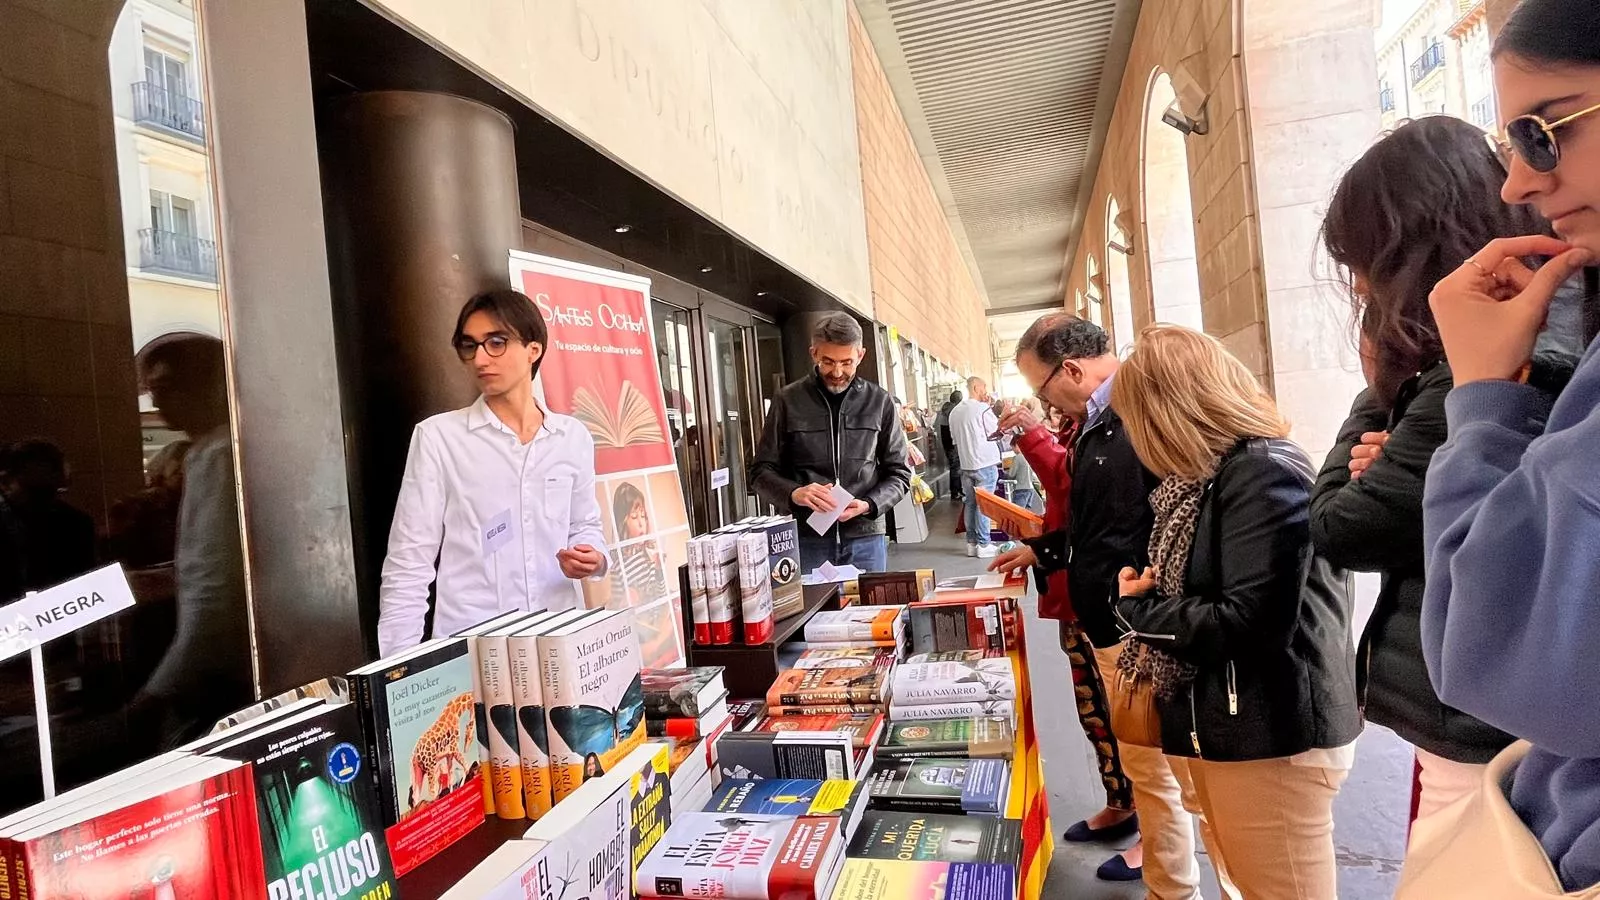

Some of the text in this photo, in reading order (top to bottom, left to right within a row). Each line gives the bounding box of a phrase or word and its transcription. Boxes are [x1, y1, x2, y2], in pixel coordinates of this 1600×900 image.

[554, 340, 564, 350] Tu
[565, 342, 592, 354] espacio
[592, 345, 601, 353] de
[602, 346, 624, 355] cultura
[770, 530, 794, 546] JAVIER
[772, 541, 794, 554] SIERRA
[36, 592, 104, 628] NEGRA
[576, 622, 632, 660] María Oruña
[484, 660, 492, 686] negro
[489, 648, 500, 698] El albatros
[518, 648, 528, 698] El albatros
[550, 648, 560, 699] El albatros
[579, 646, 629, 680] El albatros
[392, 676, 440, 705] Joël Dicker
[580, 673, 609, 696] negro
[906, 686, 976, 698] JULIA NAVARRO
[393, 708, 402, 717] La
[404, 702, 420, 713] muy
[394, 716, 414, 728] visita
[414, 711, 421, 720] al
[902, 706, 973, 718] JULIA NAVARRO
[256, 756, 265, 764] no
[266, 750, 282, 762] están
[282, 742, 304, 757] siempre
[304, 736, 320, 747] entre
[268, 742, 278, 752] Los
[279, 734, 298, 748] peores
[732, 782, 756, 810] REBAÑO
[616, 798, 624, 832] EL
[53, 848, 74, 862] Este
[75, 838, 104, 856] hogar
[106, 824, 142, 844] perfecto
[144, 816, 162, 830] solo
[163, 810, 184, 822] tiene
[186, 804, 202, 816] una
[80, 852, 94, 864] No
[96, 841, 126, 859] llames
[128, 838, 135, 846] a
[136, 832, 150, 844] las
[150, 820, 182, 840] puertas
[312, 825, 328, 853] EL
[881, 830, 898, 844] MI
[898, 818, 926, 861] QUERIDA
[924, 826, 944, 856] LUCÍA
[588, 828, 624, 892] HOMBRE
[663, 845, 693, 858] EL
[684, 832, 727, 866] ESPÍA
[711, 830, 752, 870] JORGE
[738, 838, 772, 865] DÍAZ
[268, 832, 380, 900] RECLUSO
[538, 856, 552, 896] EL
[615, 860, 624, 898] DE
